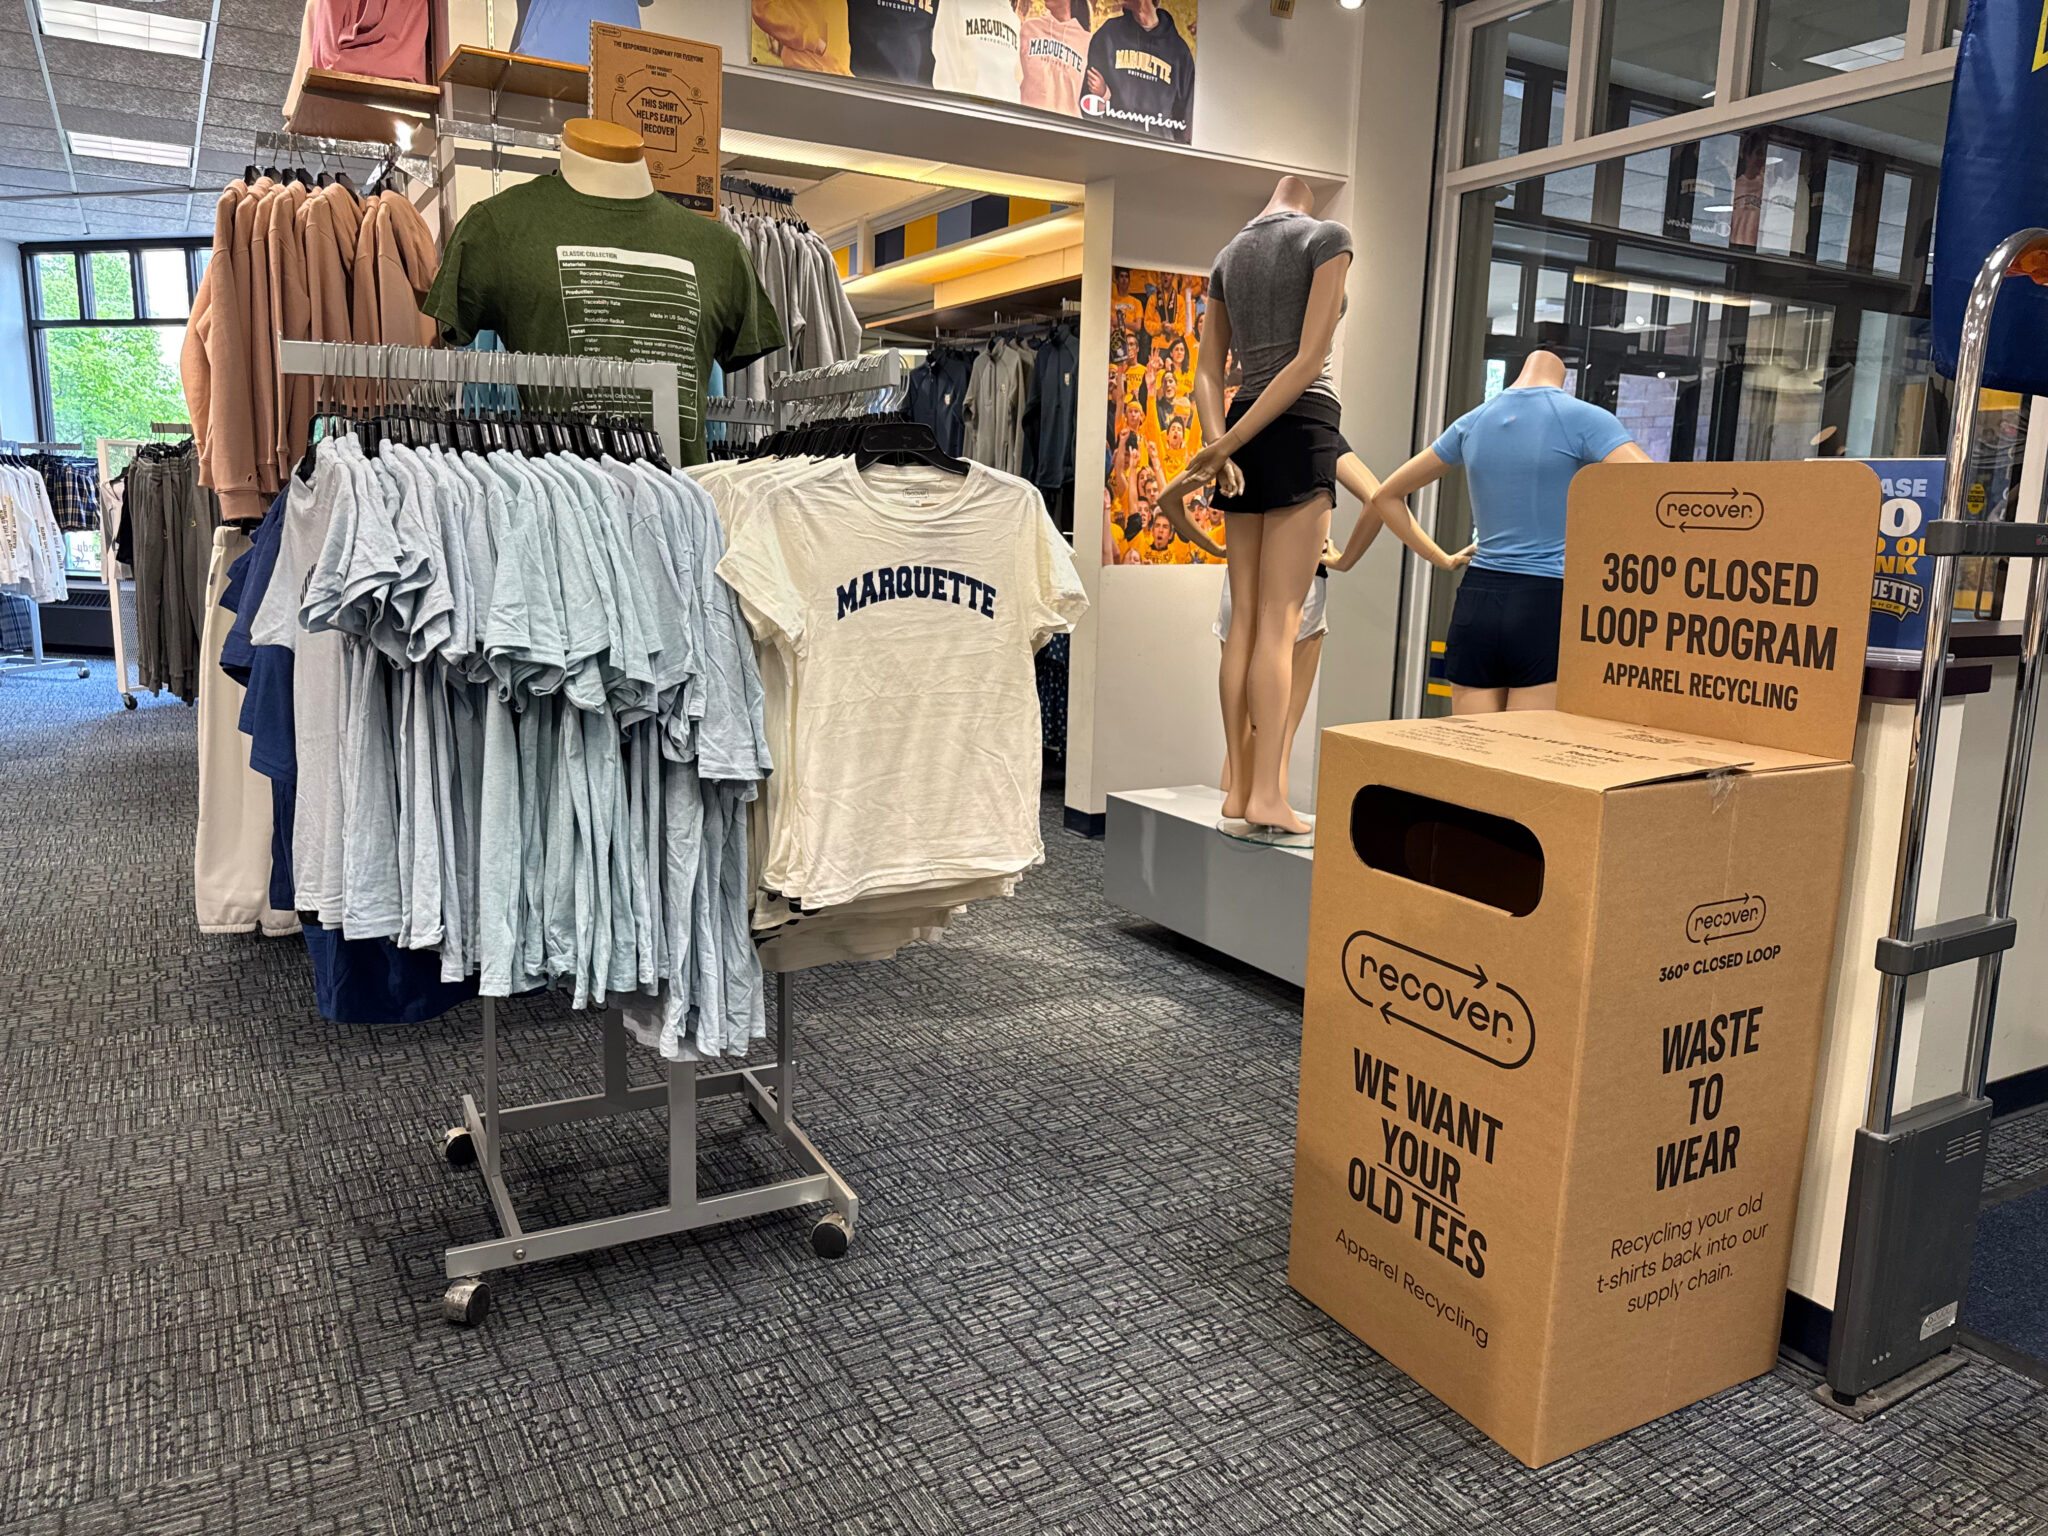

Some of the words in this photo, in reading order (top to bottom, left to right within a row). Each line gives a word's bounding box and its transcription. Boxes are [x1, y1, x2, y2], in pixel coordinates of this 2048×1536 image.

[622, 42, 652, 54] RESPONSIBLE
[652, 48, 674, 57] COMPANY
[682, 54, 704, 62] EVERYONE
[966, 18, 1018, 50] MARQUETTE
[1029, 39, 1082, 72] MARQUETTE
[1115, 49, 1172, 84] MARQUETTE
[1127, 69, 1158, 82] UNIVERSITY
[636, 110, 658, 122] HELPS
[660, 115, 683, 125] EARTH
[641, 98, 656, 108] THIS
[658, 100, 678, 112] SHIRT
[644, 123, 675, 136] RECOVER
[1080, 94, 1187, 132] Champion
[586, 252, 618, 260] COLLECTION
[1666, 500, 1752, 519] recover
[836, 566, 996, 621] MARQUETTE
[1684, 557, 1819, 607] CLOSED
[1580, 604, 1658, 649] LOOP
[1665, 612, 1838, 671] PROGRAM
[1602, 662, 1684, 695] APPAREL
[1689, 672, 1798, 712] RECYCLING
[1694, 906, 1758, 932] recover
[1692, 952, 1744, 975] CLOSED
[1746, 944, 1782, 965] LOOP
[1359, 950, 1515, 1040] recover
[1662, 1006, 1764, 1075] WASTE
[1354, 1048, 1400, 1114] WE
[1406, 1073, 1504, 1165] WANT
[1688, 1072, 1725, 1126] TO
[1380, 1116, 1462, 1205] YOUR
[1656, 1126, 1741, 1192] WEAR
[1348, 1157, 1404, 1226] OLD
[1411, 1193, 1488, 1280] TEES
[1610, 1218, 1694, 1261] Recycling
[1696, 1206, 1736, 1237] your
[1738, 1192, 1765, 1220] old
[1596, 1258, 1658, 1294] t-shirts
[1661, 1242, 1703, 1274] back
[1706, 1235, 1739, 1261] into
[1742, 1222, 1770, 1247] our
[1336, 1228, 1399, 1284] Apparel
[1403, 1272, 1490, 1350] Recycling
[1627, 1278, 1685, 1314] supply
[1688, 1262, 1734, 1290] chain.
